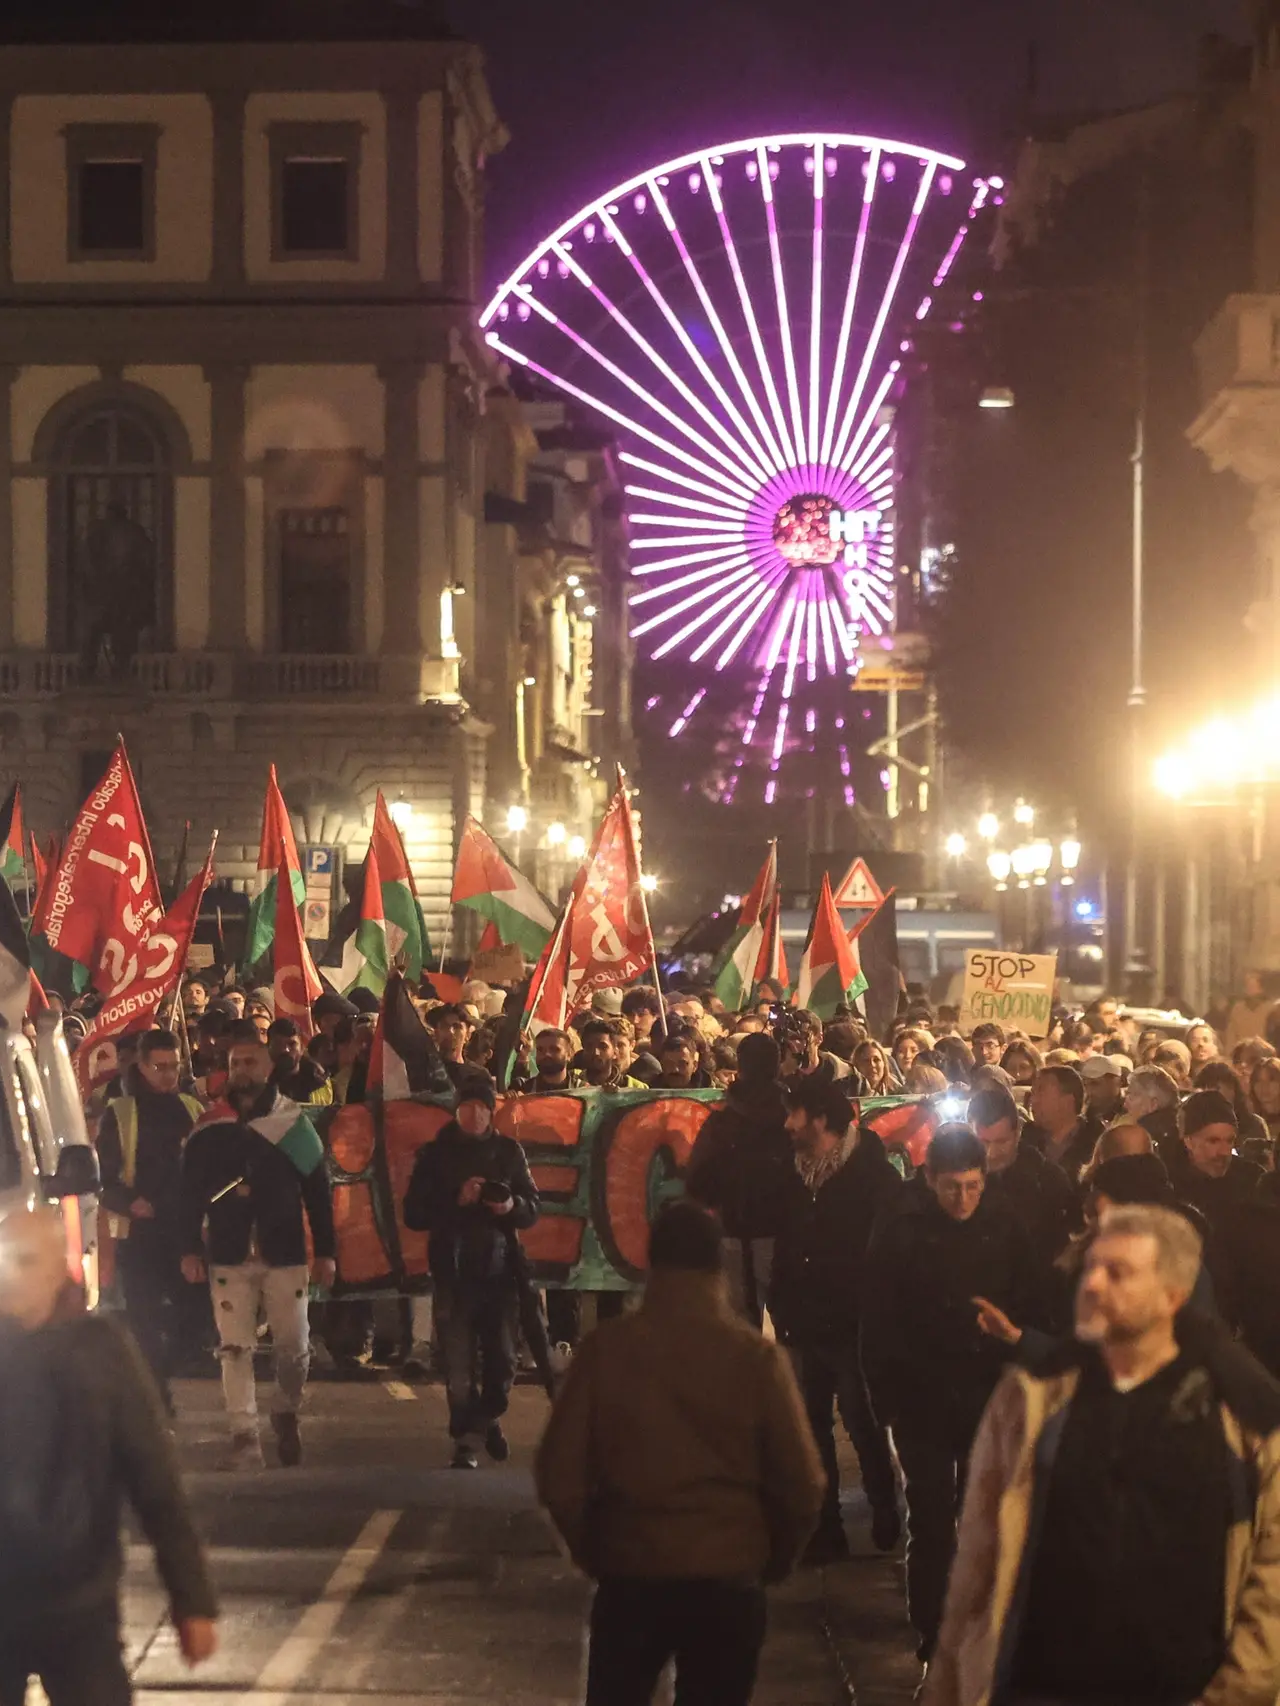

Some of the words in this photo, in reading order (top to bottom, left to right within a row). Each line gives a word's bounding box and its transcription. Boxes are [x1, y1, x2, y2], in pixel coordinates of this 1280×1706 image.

[312, 851, 328, 871] P
[971, 954, 1036, 978] STOP
[984, 976, 1007, 993] AL
